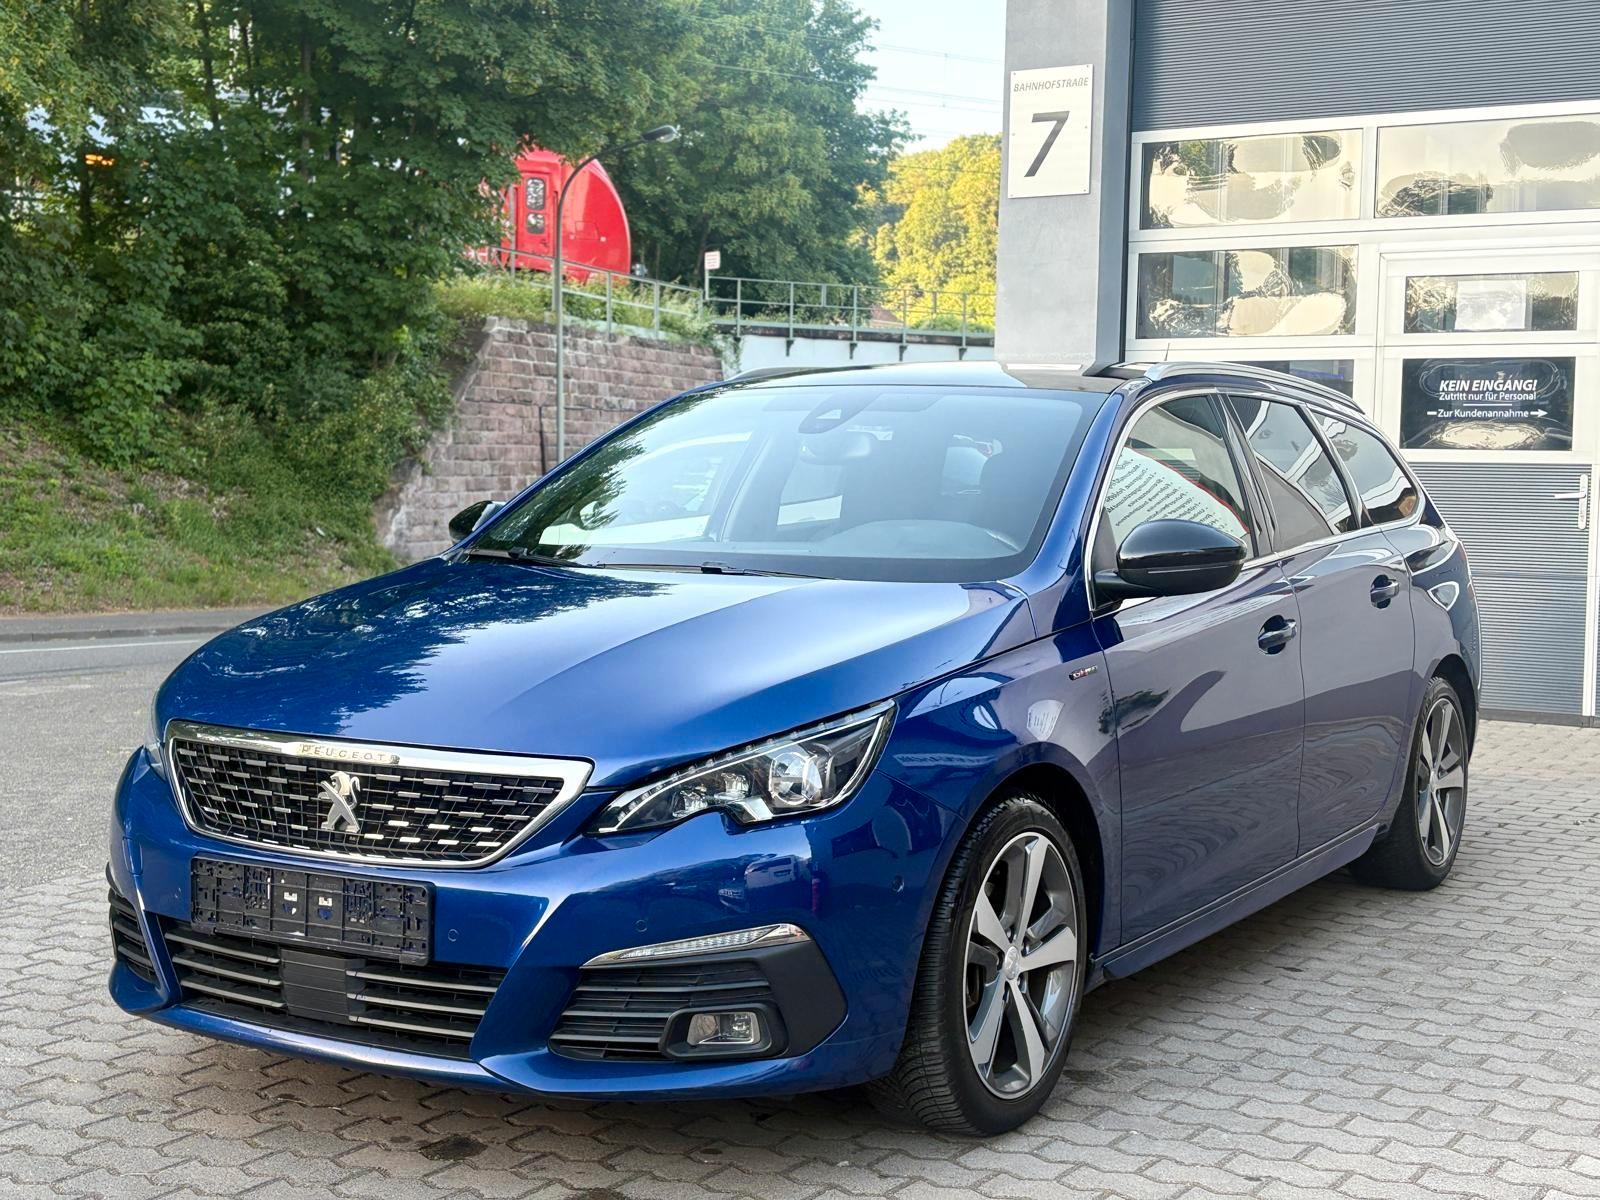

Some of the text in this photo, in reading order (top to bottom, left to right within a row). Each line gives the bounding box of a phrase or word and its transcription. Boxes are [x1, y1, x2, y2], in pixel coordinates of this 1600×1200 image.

[1024, 111, 1070, 177] 7
[1439, 379, 1538, 392] KEIN EINGANG!
[1439, 391, 1537, 401] Zutritt nur für Personal
[1437, 407, 1529, 418] Zur Kundenannahme
[301, 743, 386, 761] PEUGEOT
